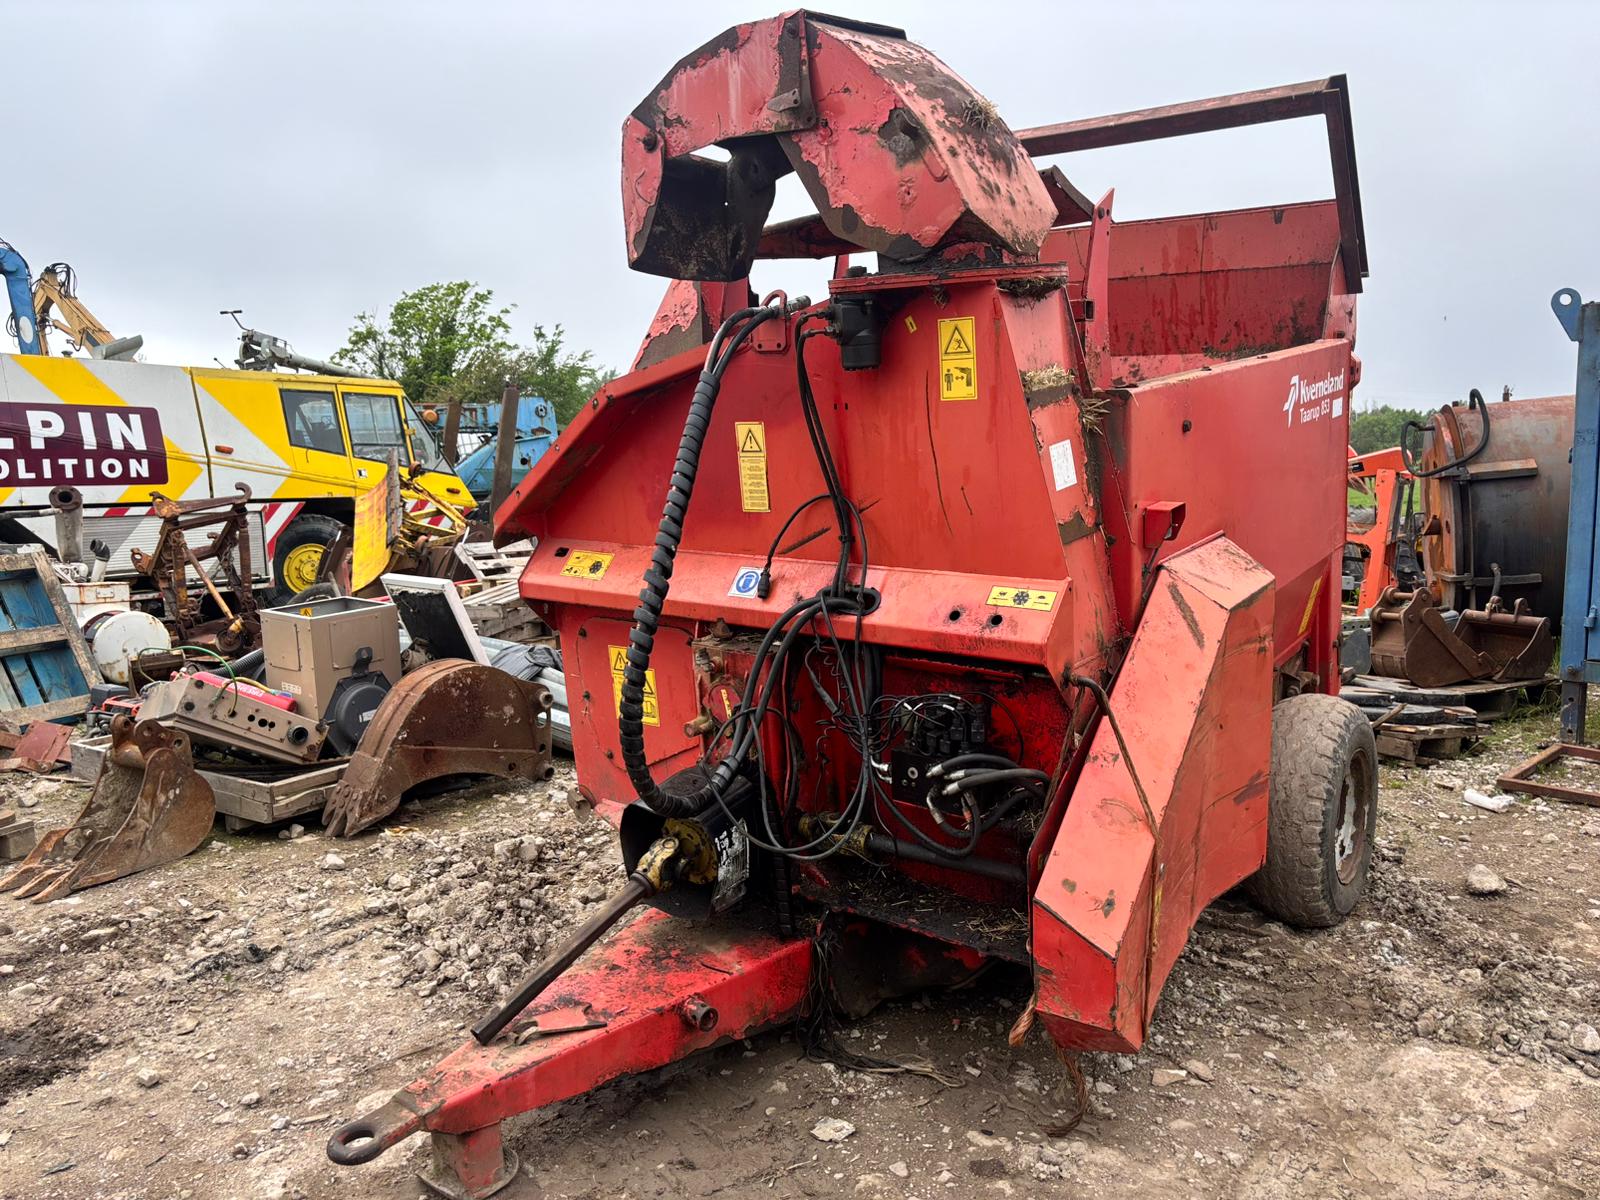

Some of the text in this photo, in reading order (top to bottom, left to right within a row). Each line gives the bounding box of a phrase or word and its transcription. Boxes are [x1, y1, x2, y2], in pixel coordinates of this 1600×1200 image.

[1300, 368, 1344, 404] Kverneland
[1300, 399, 1330, 424] Taarup 853
